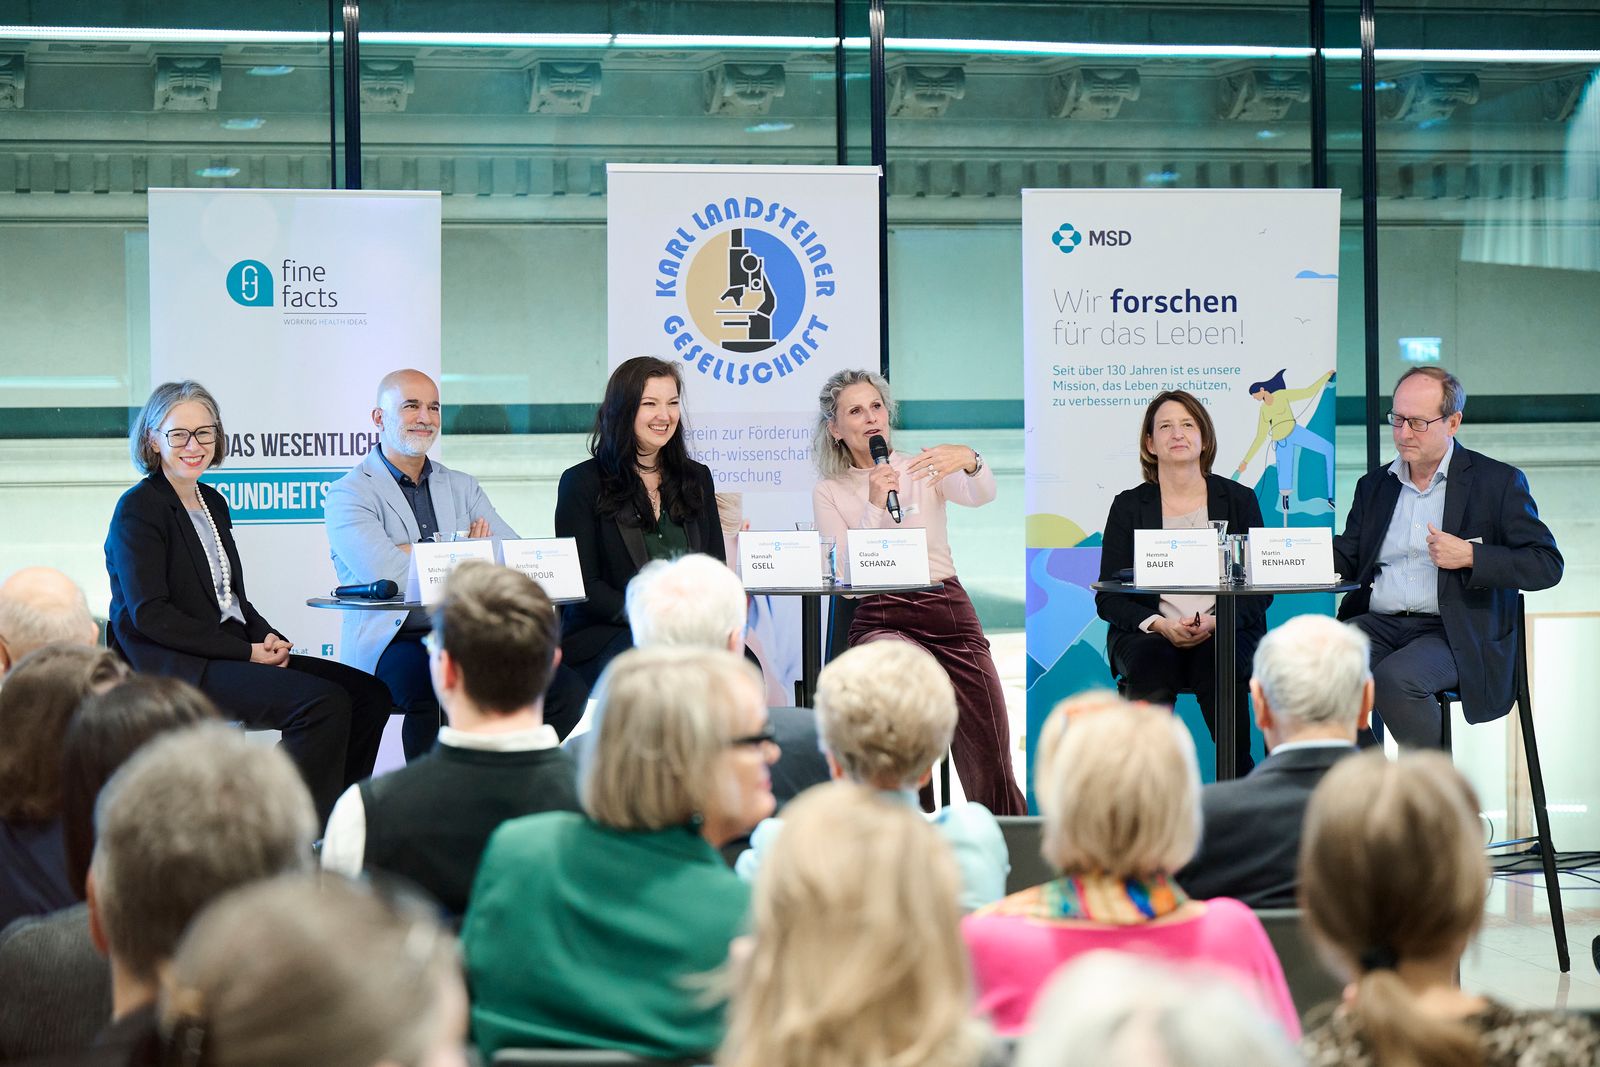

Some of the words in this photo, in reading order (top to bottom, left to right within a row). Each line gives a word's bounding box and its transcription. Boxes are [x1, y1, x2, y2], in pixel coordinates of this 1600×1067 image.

[656, 227, 697, 297] KARL
[692, 197, 836, 297] LANDSTEINER
[1089, 230, 1132, 247] MSD
[282, 259, 326, 282] fine
[282, 285, 338, 307] facts
[1053, 288, 1103, 313] Wir
[1110, 288, 1238, 313] forschen
[1053, 320, 1093, 345] für
[1100, 320, 1146, 345] das
[1156, 320, 1245, 345] Leben!
[663, 314, 829, 386] GESELLSCHAFT
[1052, 365, 1075, 376] Seit
[1078, 365, 1104, 376] über
[1108, 365, 1126, 375] 130
[1129, 365, 1168, 375] Jahren
[1170, 365, 1183, 375] ist
[1187, 367, 1200, 375] es
[1202, 366, 1241, 375] unsere
[1053, 380, 1099, 393] Mission,
[1102, 380, 1121, 391] das
[1124, 380, 1158, 391] Leben
[1161, 383, 1174, 391] zu
[1177, 380, 1231, 392] schützen,
[1053, 398, 1066, 406] zu
[1069, 395, 1131, 406] verbessern
[683, 425, 718, 441] erein
[722, 428, 744, 440] zur
[712, 467, 782, 486] Forschung
[751, 562, 775, 570] GSELL
[1146, 560, 1175, 568] BAUER
[1262, 558, 1306, 566] RENHARDT
